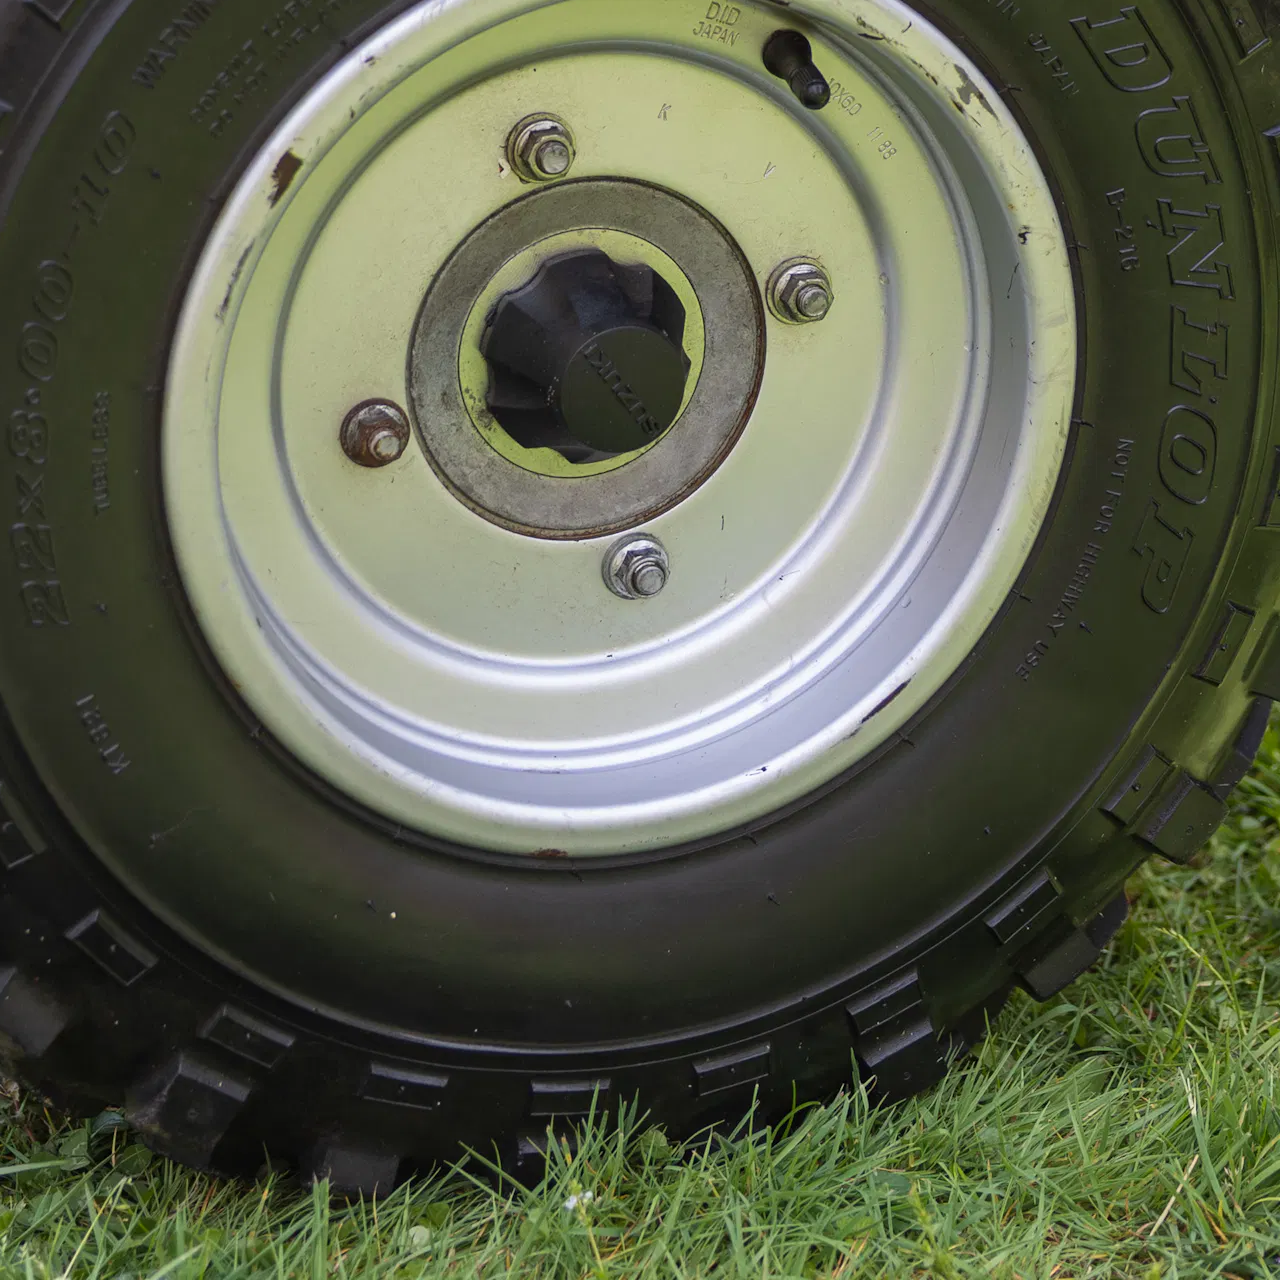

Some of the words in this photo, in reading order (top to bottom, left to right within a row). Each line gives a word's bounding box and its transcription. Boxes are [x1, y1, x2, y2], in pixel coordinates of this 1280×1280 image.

[692, 21, 741, 49] JAPAN
[1026, 31, 1081, 101] JAPAN
[1068, 5, 1237, 615] DUNLOP
[580, 343, 663, 439] SUZUKI
[1110, 435, 1136, 487] NOT
[1092, 487, 1123, 536] FOR
[1045, 539, 1105, 639] HIGHWAY
[1014, 638, 1051, 683] USE
